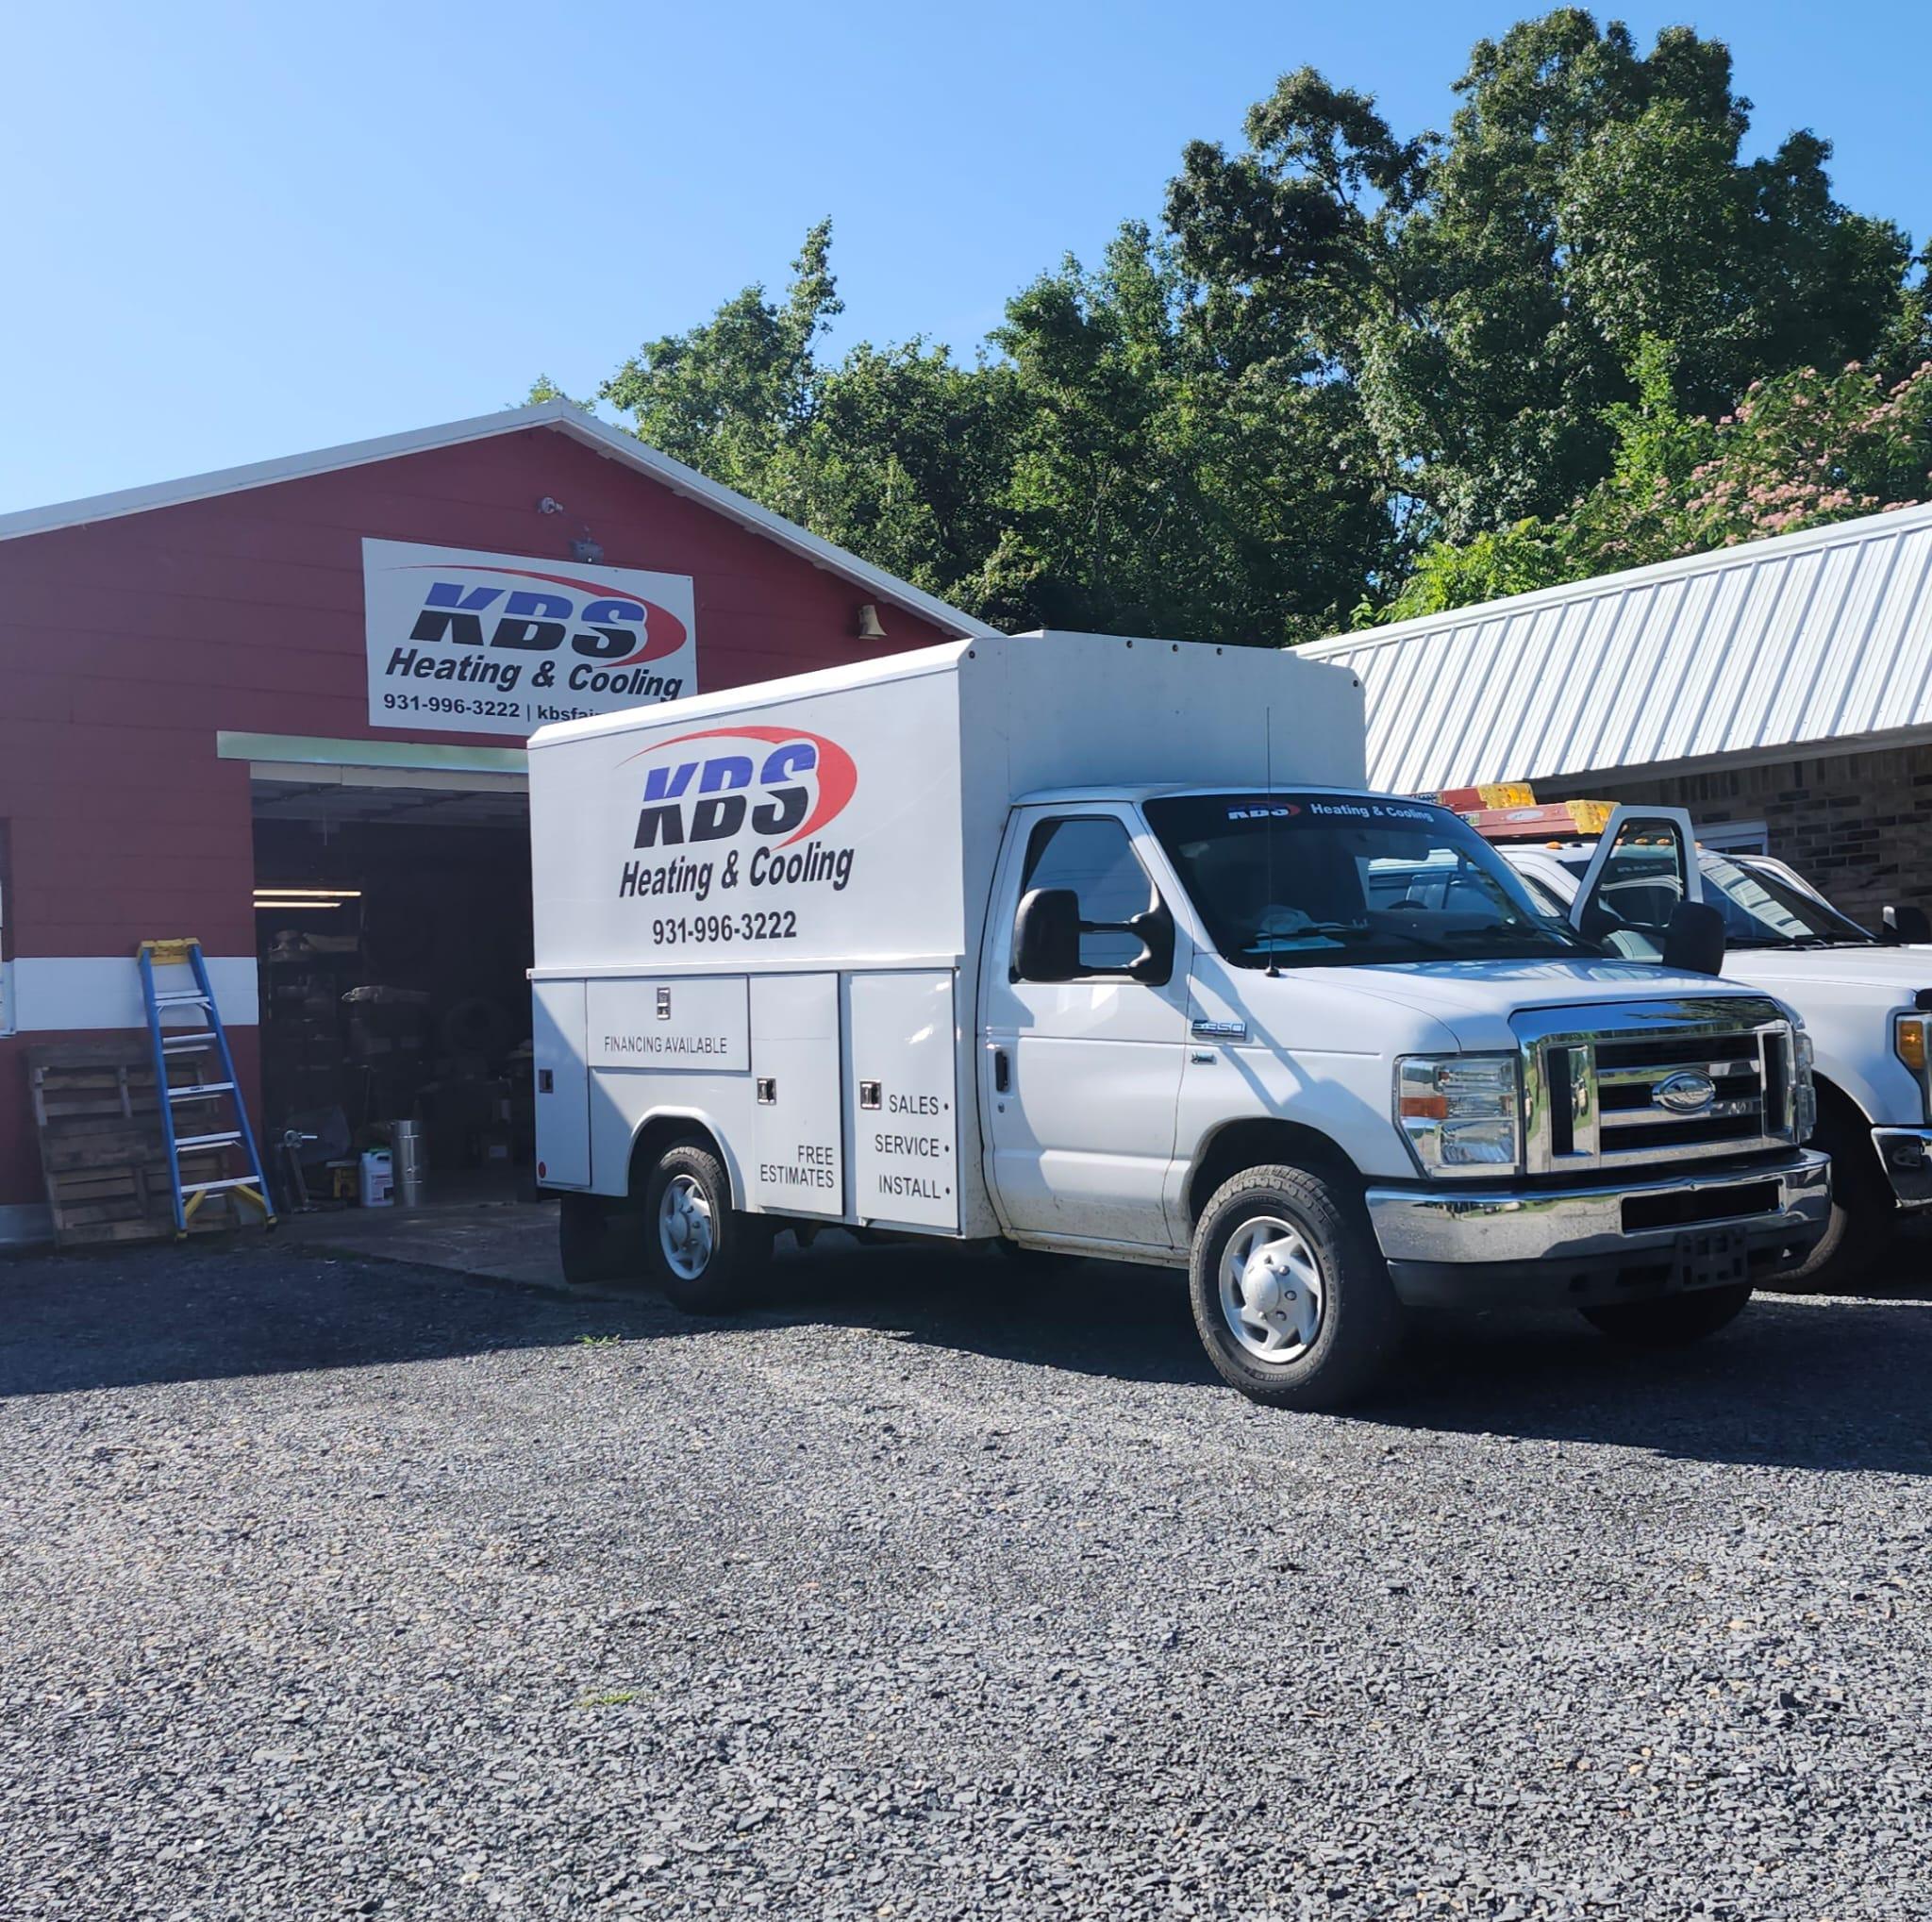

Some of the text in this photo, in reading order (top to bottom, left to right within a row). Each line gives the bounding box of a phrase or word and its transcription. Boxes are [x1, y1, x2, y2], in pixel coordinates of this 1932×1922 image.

[410, 581, 645, 659] KBS
[385, 647, 683, 703] Heating & Cooling
[383, 694, 521, 718] 931-996-3222
[633, 743, 817, 850] KBS
[1309, 803, 1371, 818] Heating
[1372, 806, 1384, 816] &
[1386, 807, 1434, 823] Cooling
[619, 841, 855, 902] Heating & Cooling
[652, 911, 797, 944] 931-996-3222
[604, 1035, 727, 1054] FINANCING AVAILABLE
[889, 1095, 939, 1115] SALES
[797, 1145, 834, 1166] FREE
[874, 1134, 940, 1158] SERVICE
[760, 1163, 835, 1189] ESTIMATES
[878, 1175, 941, 1199] INSTALL
